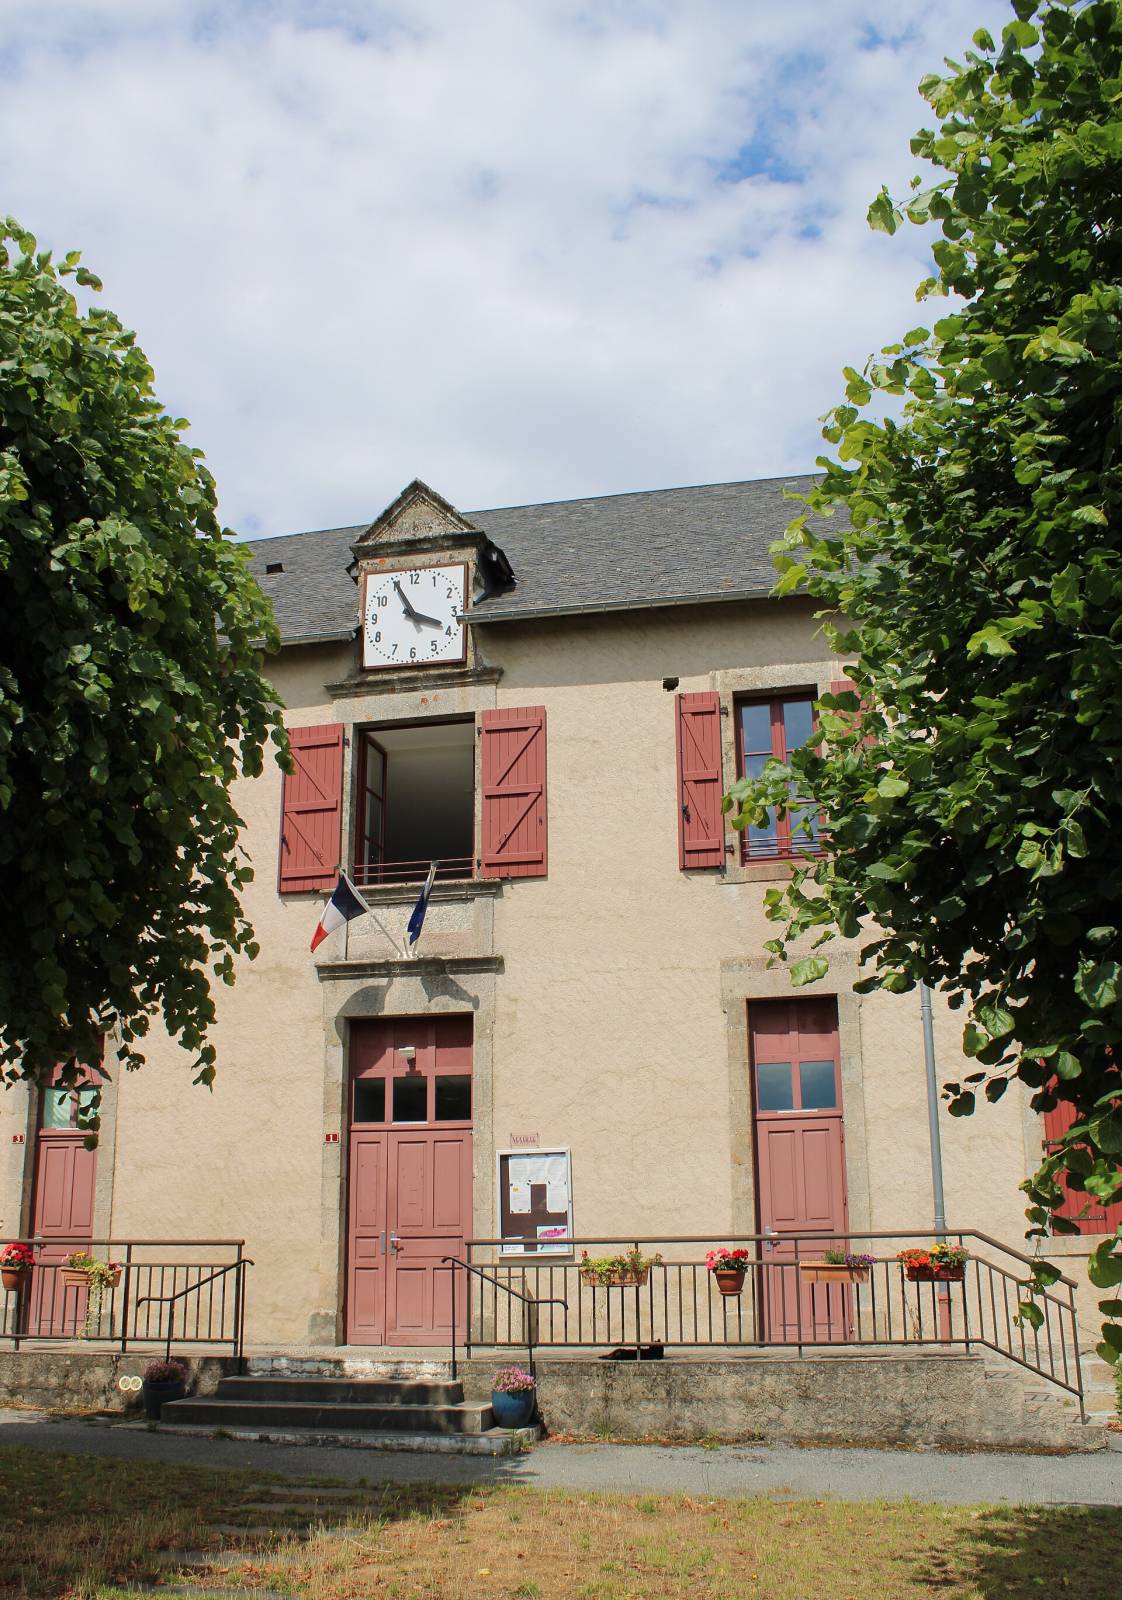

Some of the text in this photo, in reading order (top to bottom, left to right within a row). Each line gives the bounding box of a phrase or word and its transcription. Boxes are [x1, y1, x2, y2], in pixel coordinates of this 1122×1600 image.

[409, 573, 420, 585] 12
[432, 576, 436, 587] 1
[446, 587, 453, 599] 2
[377, 595, 388, 607] 10
[451, 605, 457, 617] 3
[371, 613, 378, 625] 9
[374, 631, 381, 643] 8
[445, 625, 452, 637] 4
[392, 643, 398, 655] 7
[430, 640, 438, 652] 5
[409, 647, 416, 659] 6
